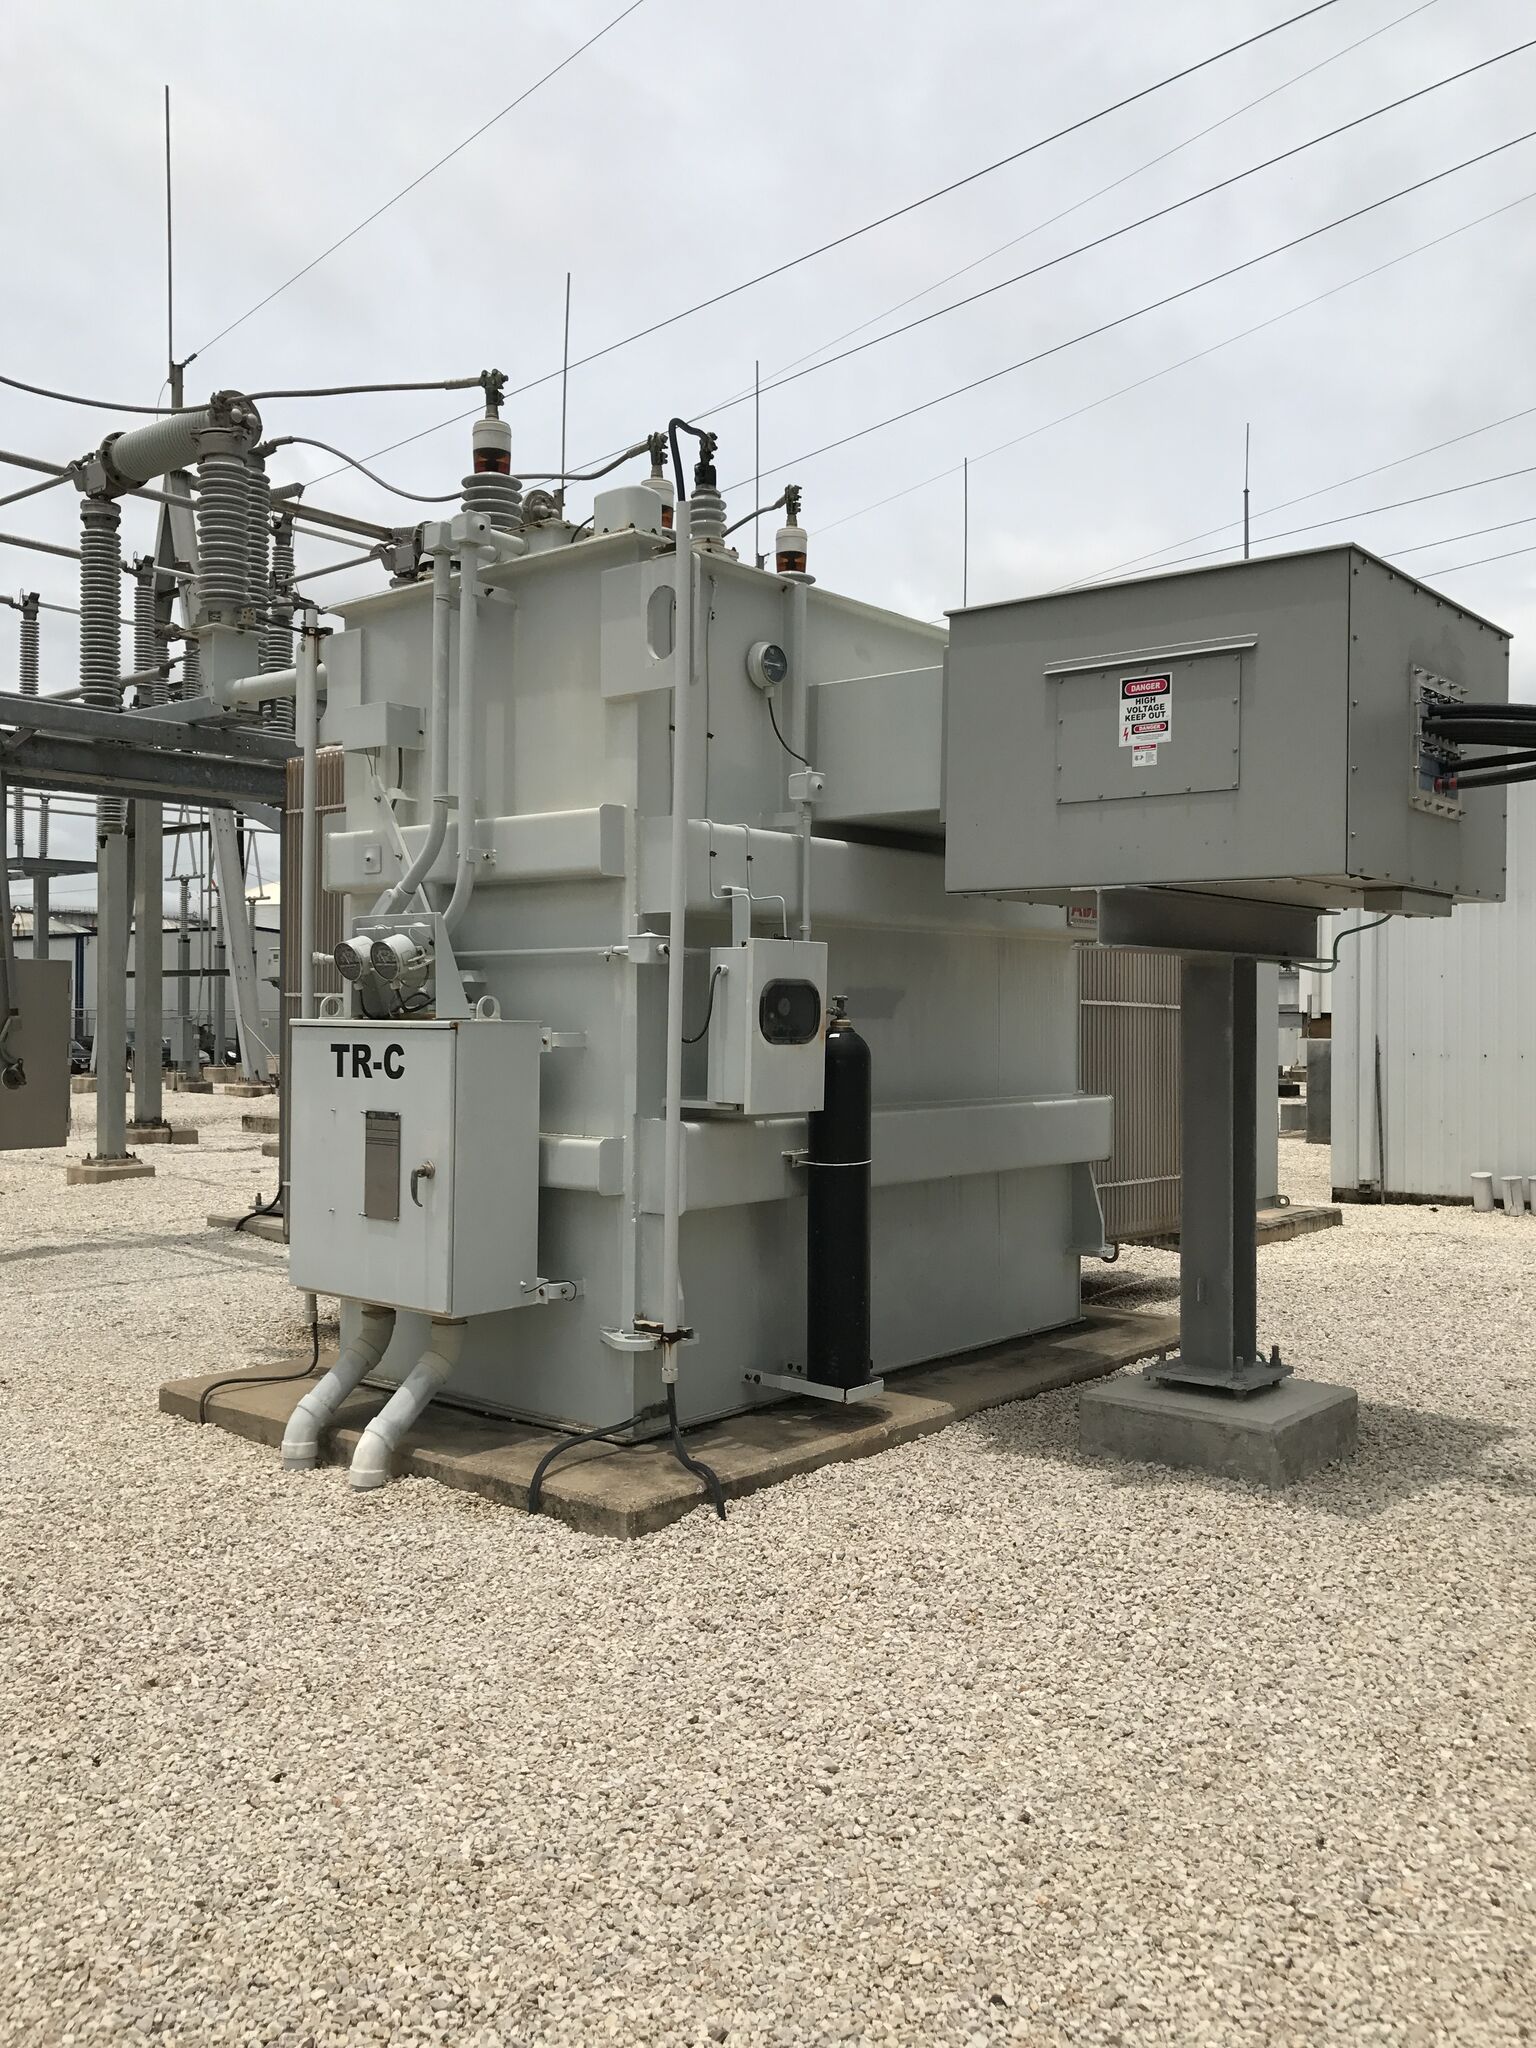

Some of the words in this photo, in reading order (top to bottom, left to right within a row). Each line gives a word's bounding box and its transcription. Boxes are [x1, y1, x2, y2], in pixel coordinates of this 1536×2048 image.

[1130, 682, 1160, 692] DANGER
[1135, 696, 1156, 705] HIGH
[1126, 703, 1165, 714] VOLTAGE
[1125, 714, 1146, 722] KEEP
[1148, 711, 1166, 720] OUT
[330, 1043, 405, 1079] TR-C
